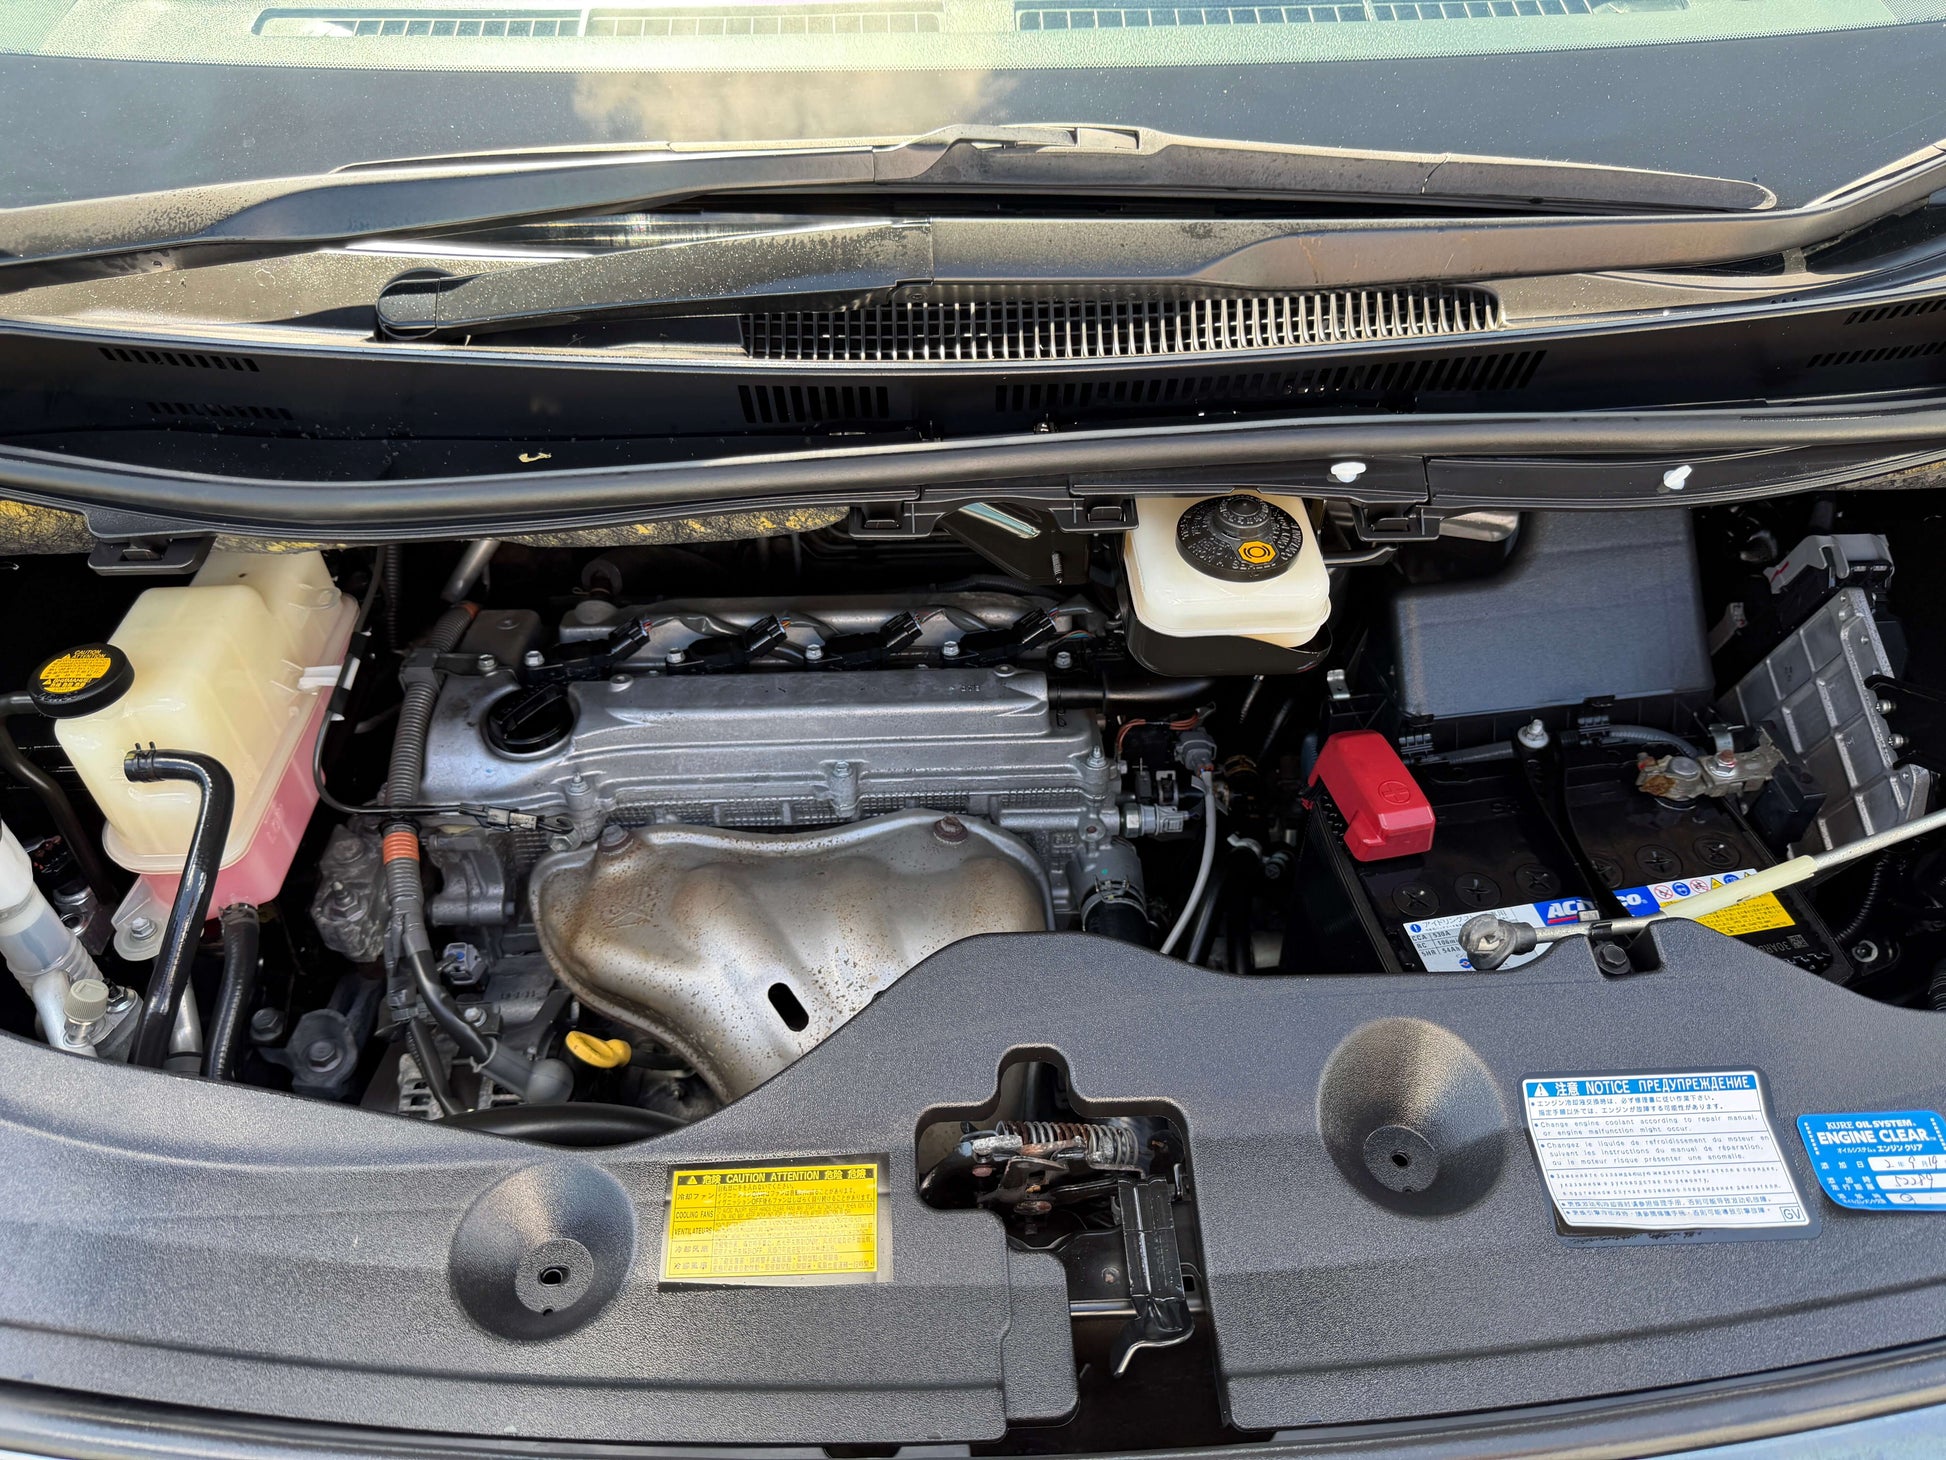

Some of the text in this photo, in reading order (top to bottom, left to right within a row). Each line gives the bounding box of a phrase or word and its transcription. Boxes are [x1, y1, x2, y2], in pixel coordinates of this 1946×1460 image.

[1432, 931, 1451, 939] 530A
[1442, 945, 1461, 954] 54Ah
[1555, 1076, 1750, 1096] 注意 NOTICE ПРЕДУПРЕЖДЕНИЕ
[1540, 1120, 1568, 1128] Change
[1574, 1119, 1600, 1127] engine
[1605, 1118, 1634, 1126] coolant
[1640, 1117, 1678, 1125] according
[1698, 1115, 1721, 1123] repair
[1826, 1121, 1854, 1130] KURE
[1856, 1120, 1872, 1128] OIL
[1558, 1129, 1582, 1137] engine
[1588, 1127, 1634, 1135] malfunction
[1816, 1128, 1930, 1145] ENGINE CLEAR
[1547, 1142, 1580, 1150] Changez
[1646, 1138, 1706, 1146] refroidissement
[702, 1174, 722, 1184] 危険
[726, 1173, 766, 1184] CAUTION
[770, 1170, 820, 1182] ATTENTION
[677, 1192, 714, 1200] 冷却ファン
[675, 1210, 698, 1219] COOLING
[700, 1210, 714, 1218] FANS
[1784, 1208, 1800, 1220] GV
[674, 1226, 712, 1236] VENTILATEURS
